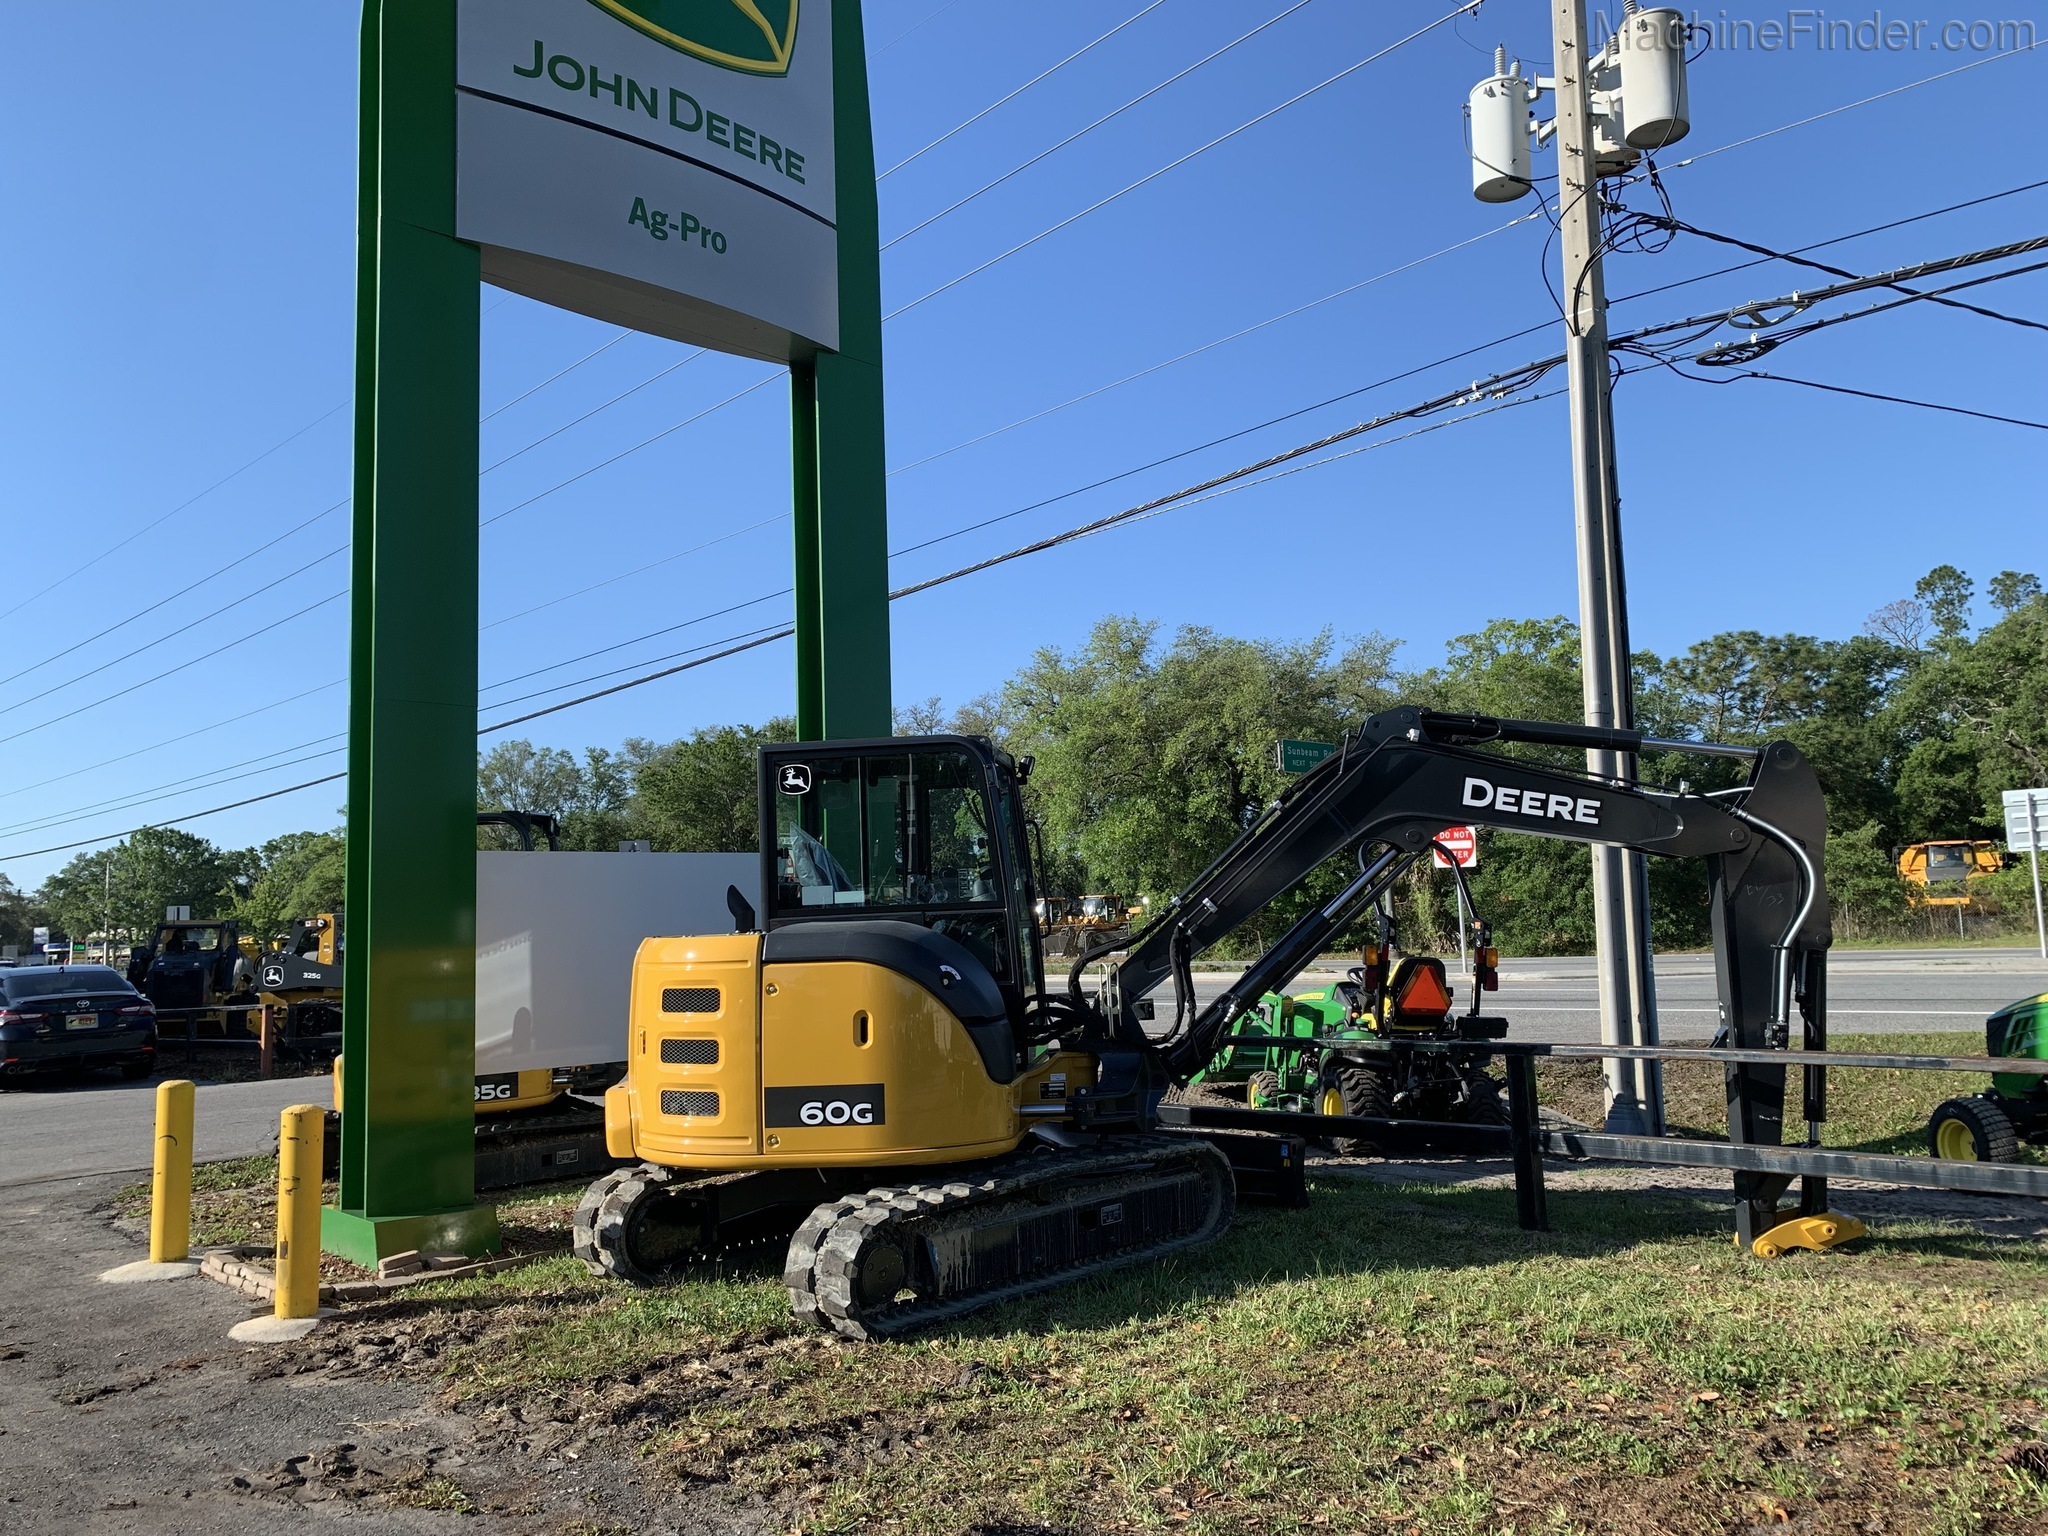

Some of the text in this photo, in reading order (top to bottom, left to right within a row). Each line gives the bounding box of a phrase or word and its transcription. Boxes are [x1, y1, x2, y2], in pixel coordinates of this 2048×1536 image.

[513, 39, 806, 185] JOHN DEERE
[628, 196, 727, 254] Ag-Pro
[1287, 746, 1319, 757] Sunbeam
[1462, 777, 1601, 825] DEERE
[1440, 831, 1450, 839] DO
[1441, 851, 1469, 859] TER
[800, 1101, 873, 1125] 60G
